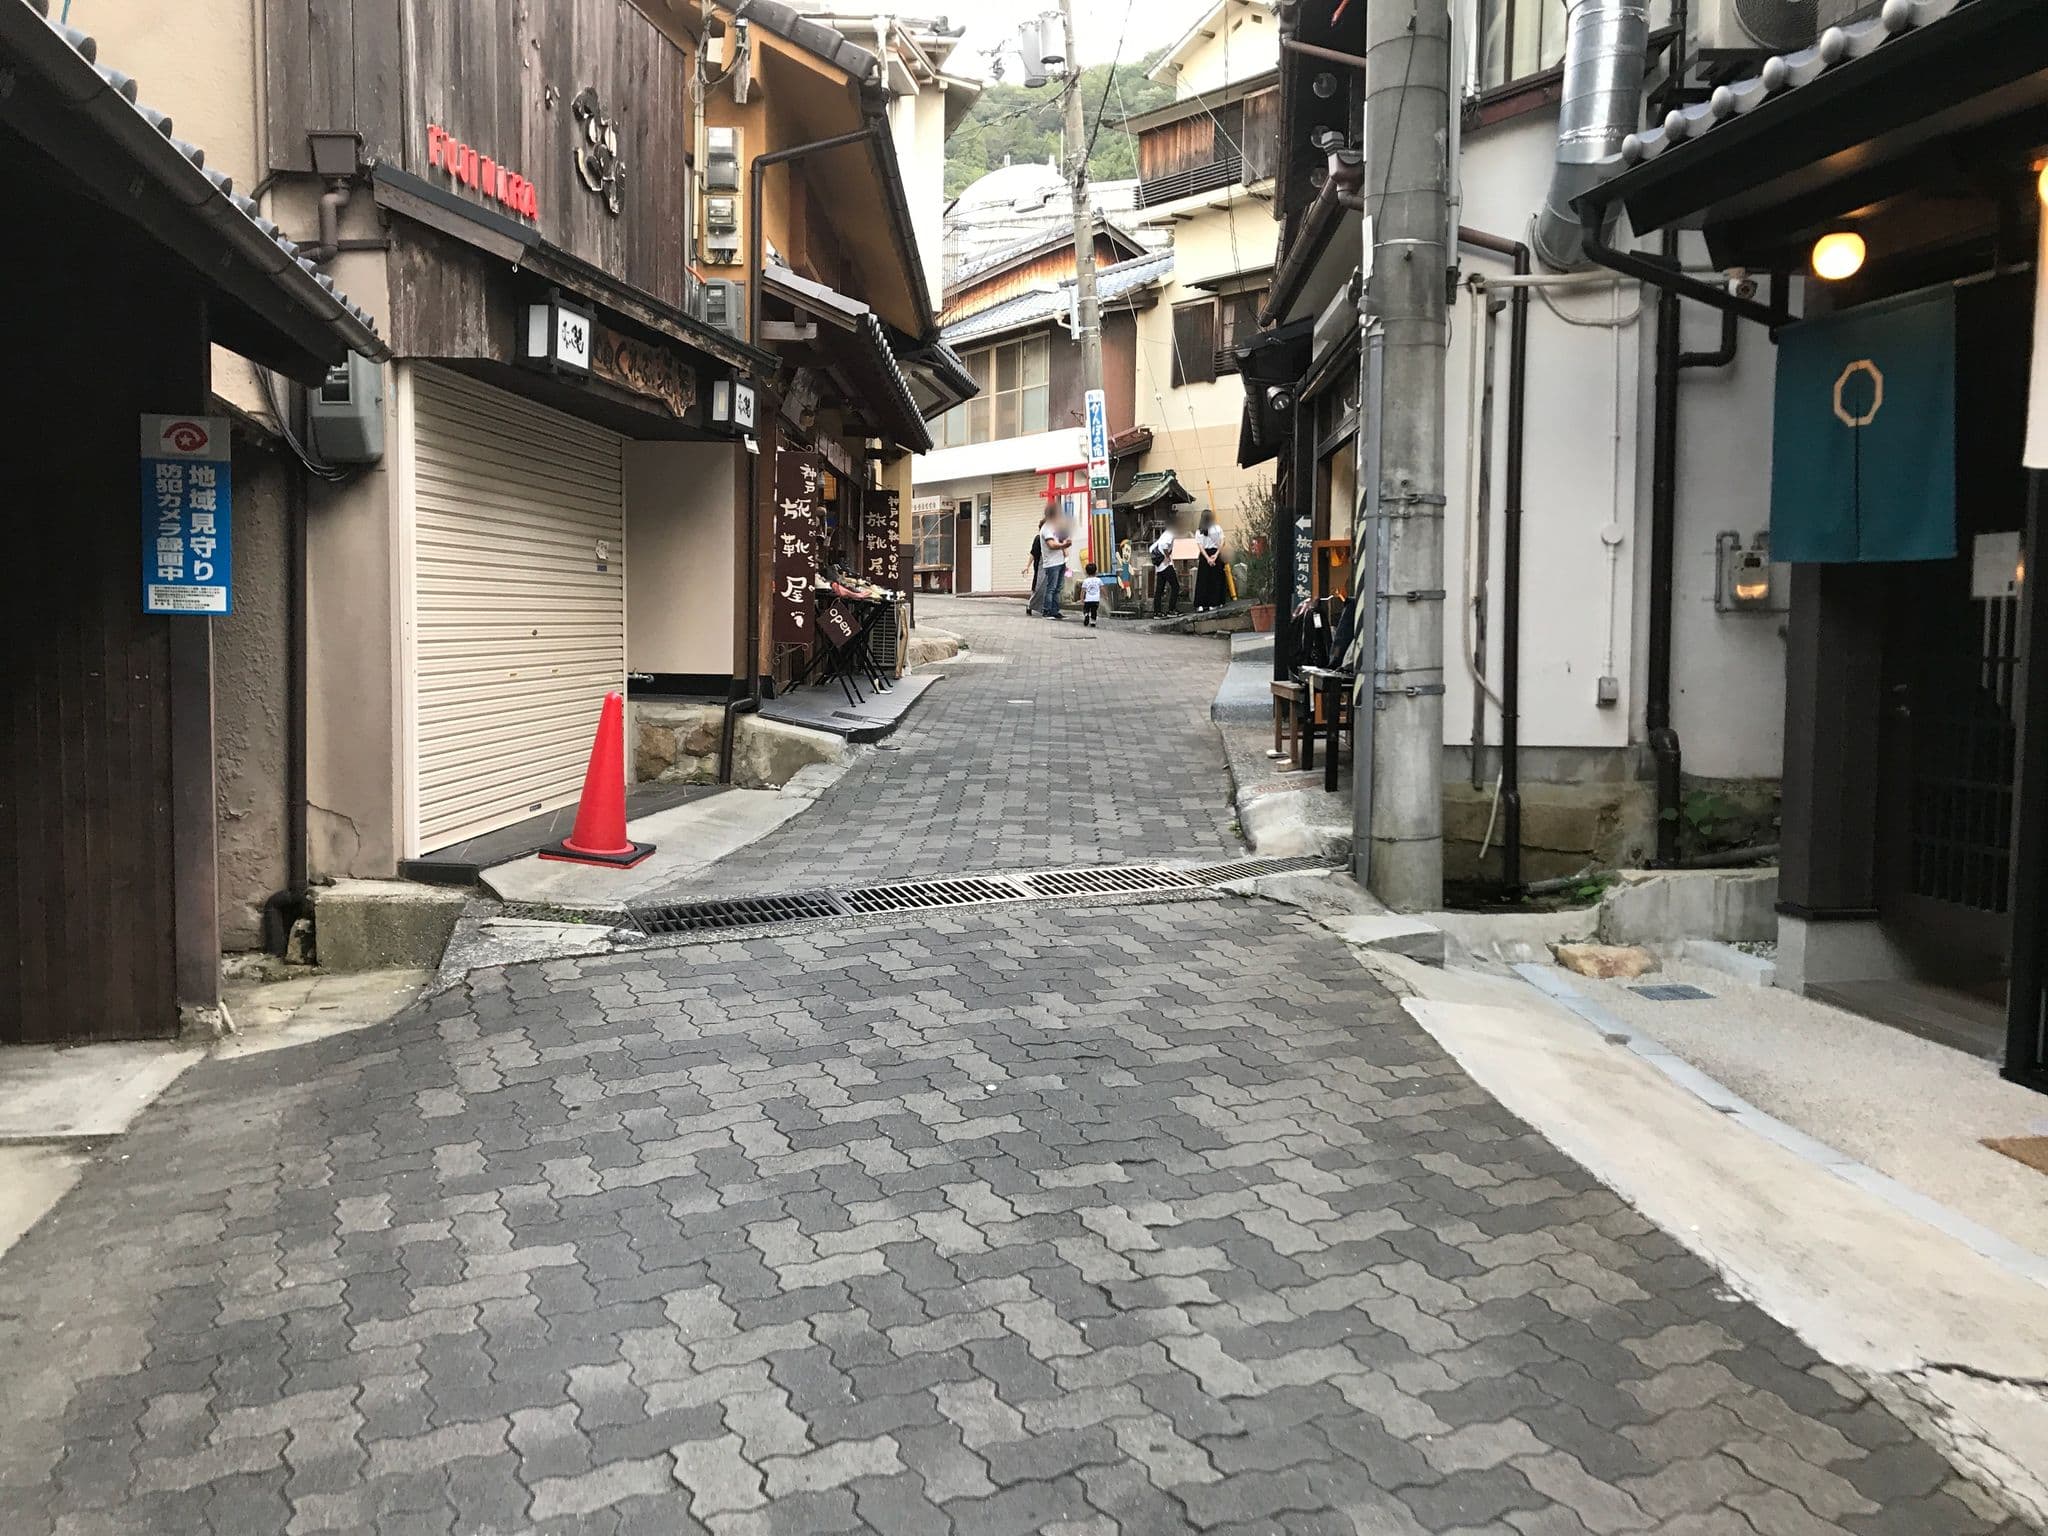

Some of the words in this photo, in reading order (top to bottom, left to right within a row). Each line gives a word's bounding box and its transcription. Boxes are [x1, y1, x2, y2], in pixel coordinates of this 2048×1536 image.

[800, 463, 817, 494] 神戸
[155, 463, 184, 581] 防犯カメラ録画中
[188, 464, 217, 581] 地域見守り
[779, 498, 812, 603] 旅靴屋
[865, 511, 887, 576] 旅靴屋
[829, 608, 852, 637] open
